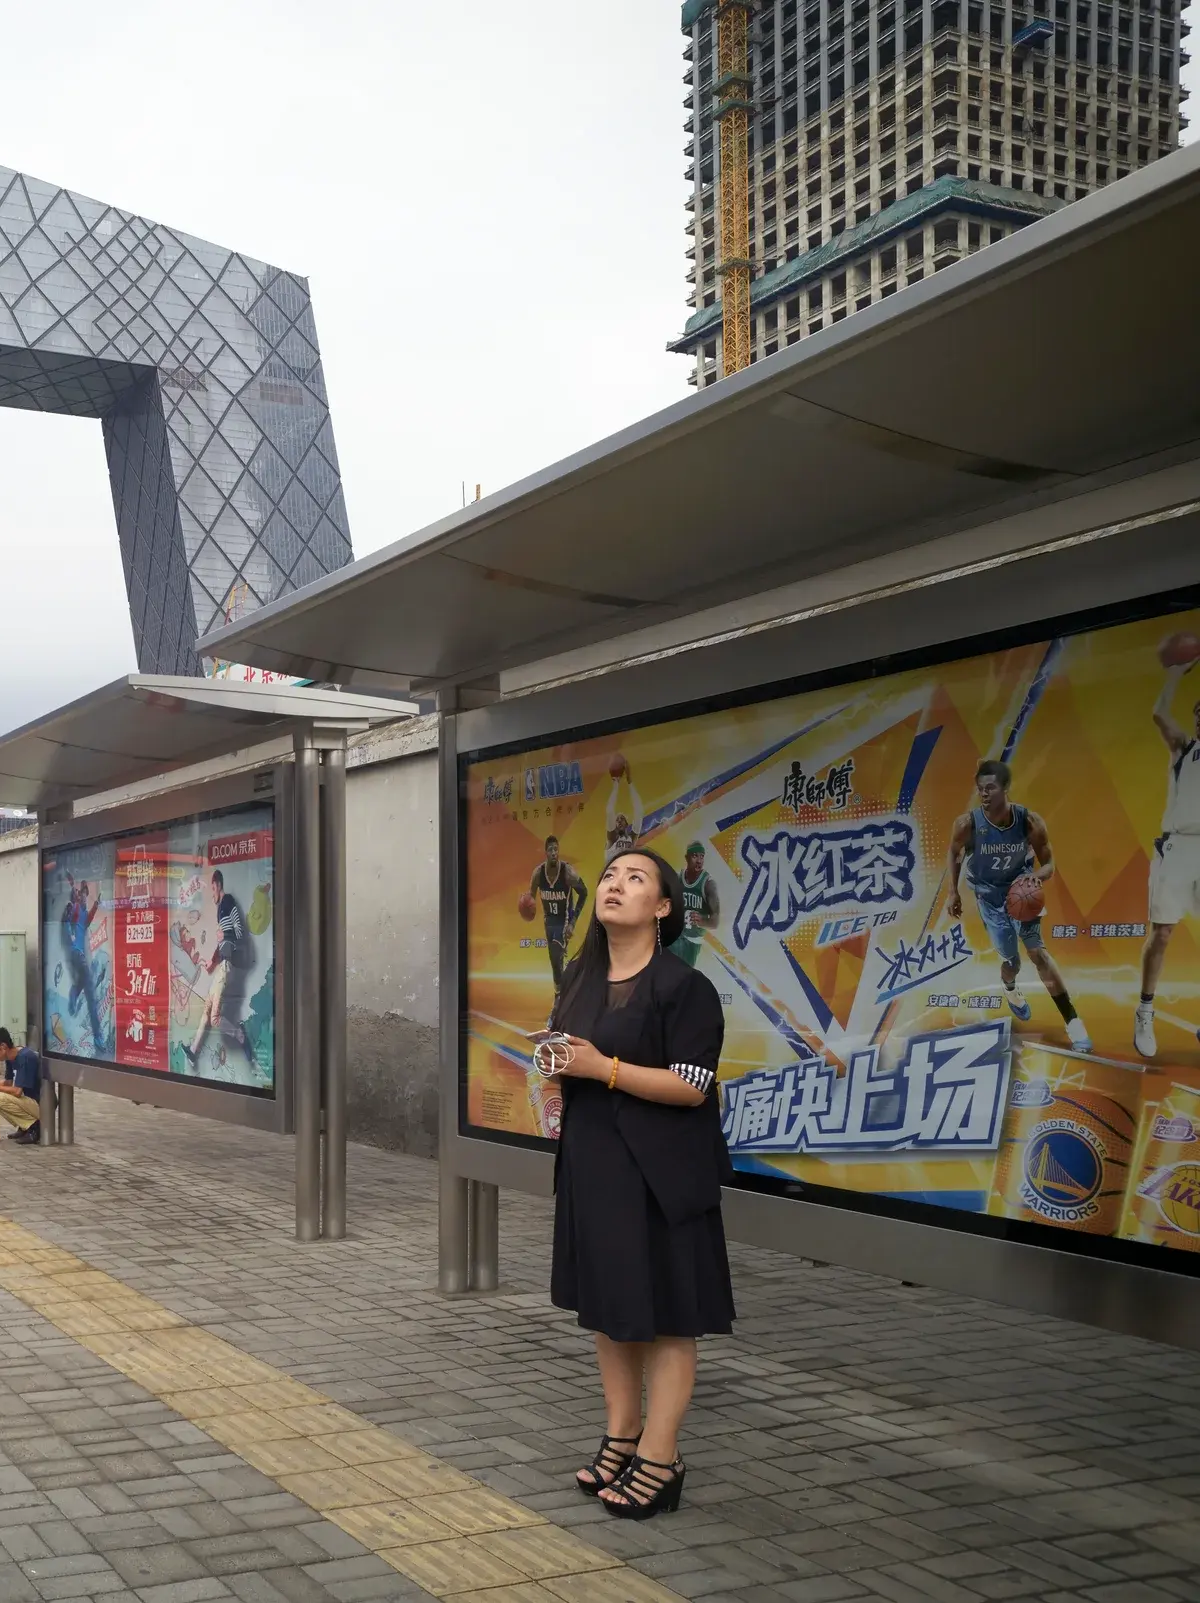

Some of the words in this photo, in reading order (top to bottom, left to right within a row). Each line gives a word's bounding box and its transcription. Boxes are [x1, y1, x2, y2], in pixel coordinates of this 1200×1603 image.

[538, 761, 584, 799] NBA
[211, 842, 238, 860] JD.COM
[238, 838, 257, 856] 京东
[980, 841, 1025, 855] MINNESOTA
[991, 856, 1012, 870] 22
[736, 826, 908, 947] 冰红茶
[549, 902, 558, 915] 13
[817, 915, 869, 945] ICE
[873, 910, 898, 928] TEA
[875, 923, 973, 990] 冰力十足
[722, 1027, 1000, 1147] 痛快上场
[1028, 1120, 1075, 1139] GOLDEN
[1078, 1126, 1108, 1158] STATE
[1020, 1184, 1100, 1222] WARRIORS
